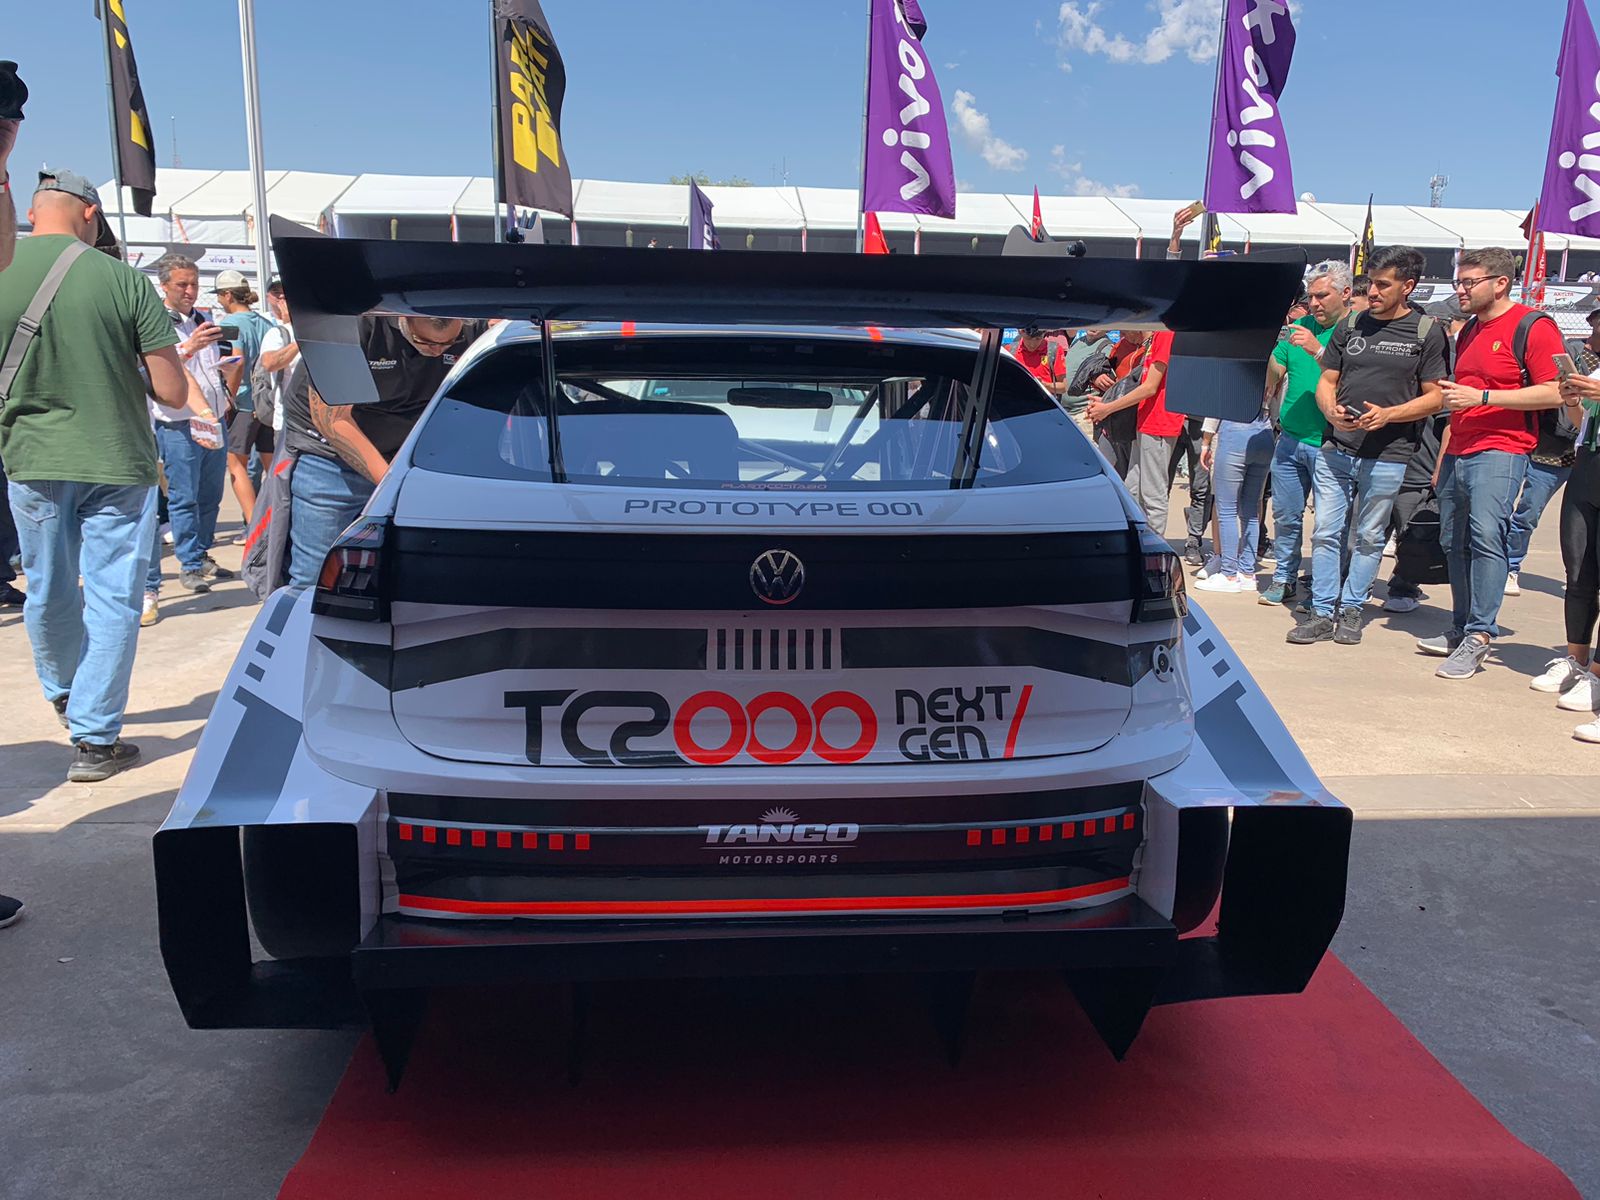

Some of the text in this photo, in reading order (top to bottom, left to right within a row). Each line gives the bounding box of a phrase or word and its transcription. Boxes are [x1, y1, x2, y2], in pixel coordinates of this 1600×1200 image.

[1558, 69, 1600, 222] viv
[1370, 344, 1412, 353] PETRONA
[624, 499, 924, 517] PROTOTYPE 001
[894, 685, 1012, 725] NEXT
[503, 689, 878, 766] TC2000
[898, 725, 991, 762] GEN
[698, 822, 860, 844] TANGO
[719, 854, 839, 865] MOTORSPORTS
